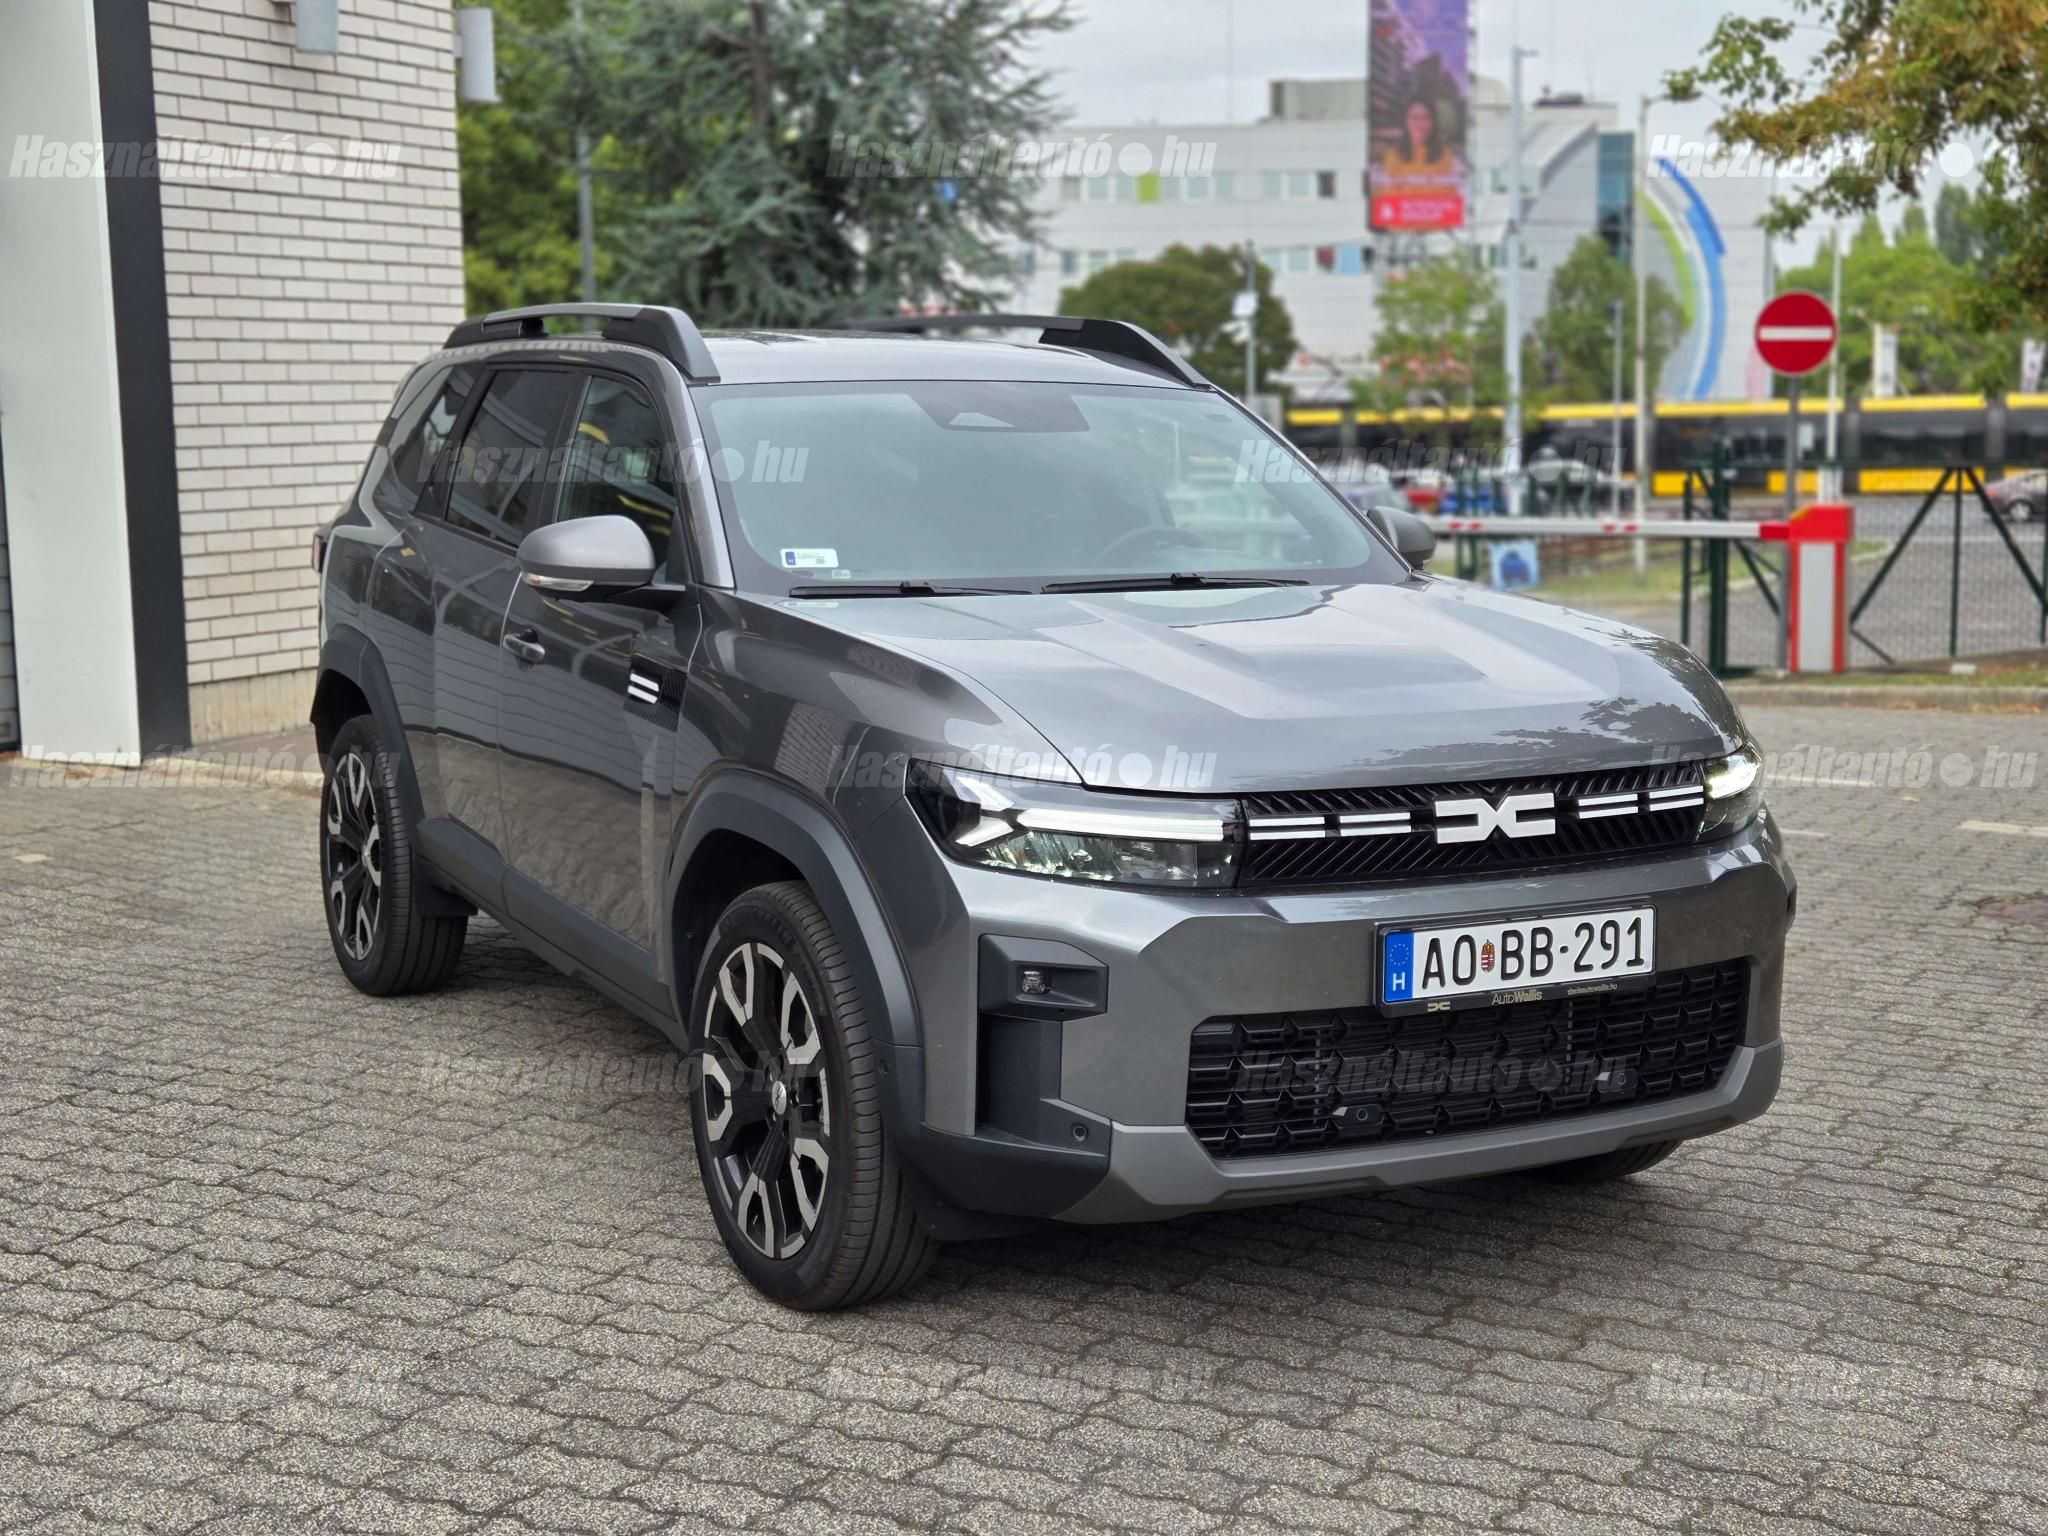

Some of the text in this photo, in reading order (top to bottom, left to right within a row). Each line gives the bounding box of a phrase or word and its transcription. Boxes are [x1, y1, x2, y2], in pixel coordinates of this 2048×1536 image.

[1422, 917, 1645, 989] AO BB-291
[1392, 972, 1406, 991] H
[1491, 988, 1543, 1006] AutoWallis
